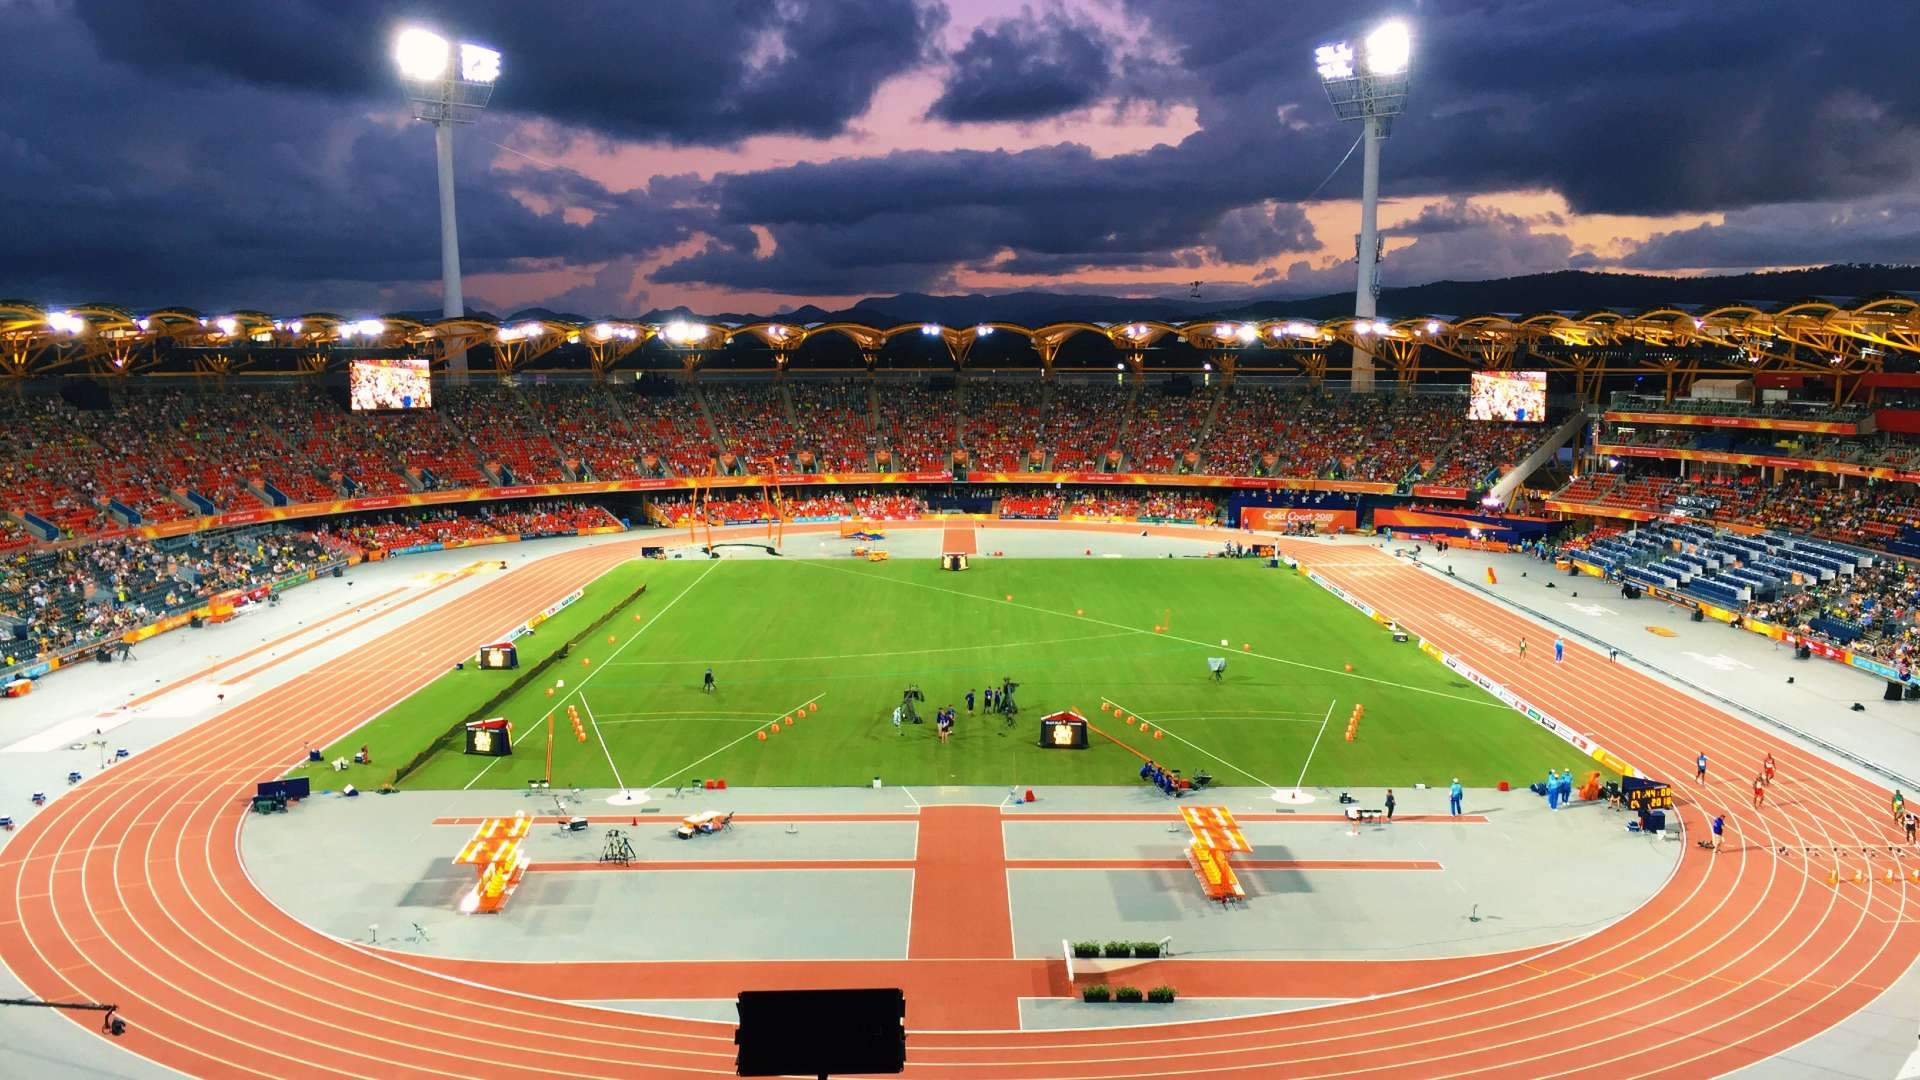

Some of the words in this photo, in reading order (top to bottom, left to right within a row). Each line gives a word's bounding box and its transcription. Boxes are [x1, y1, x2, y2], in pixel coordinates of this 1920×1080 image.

[1263, 510, 1285, 520] Gold
[1287, 511, 1312, 521] Coast
[1314, 512, 1334, 522] 2018
